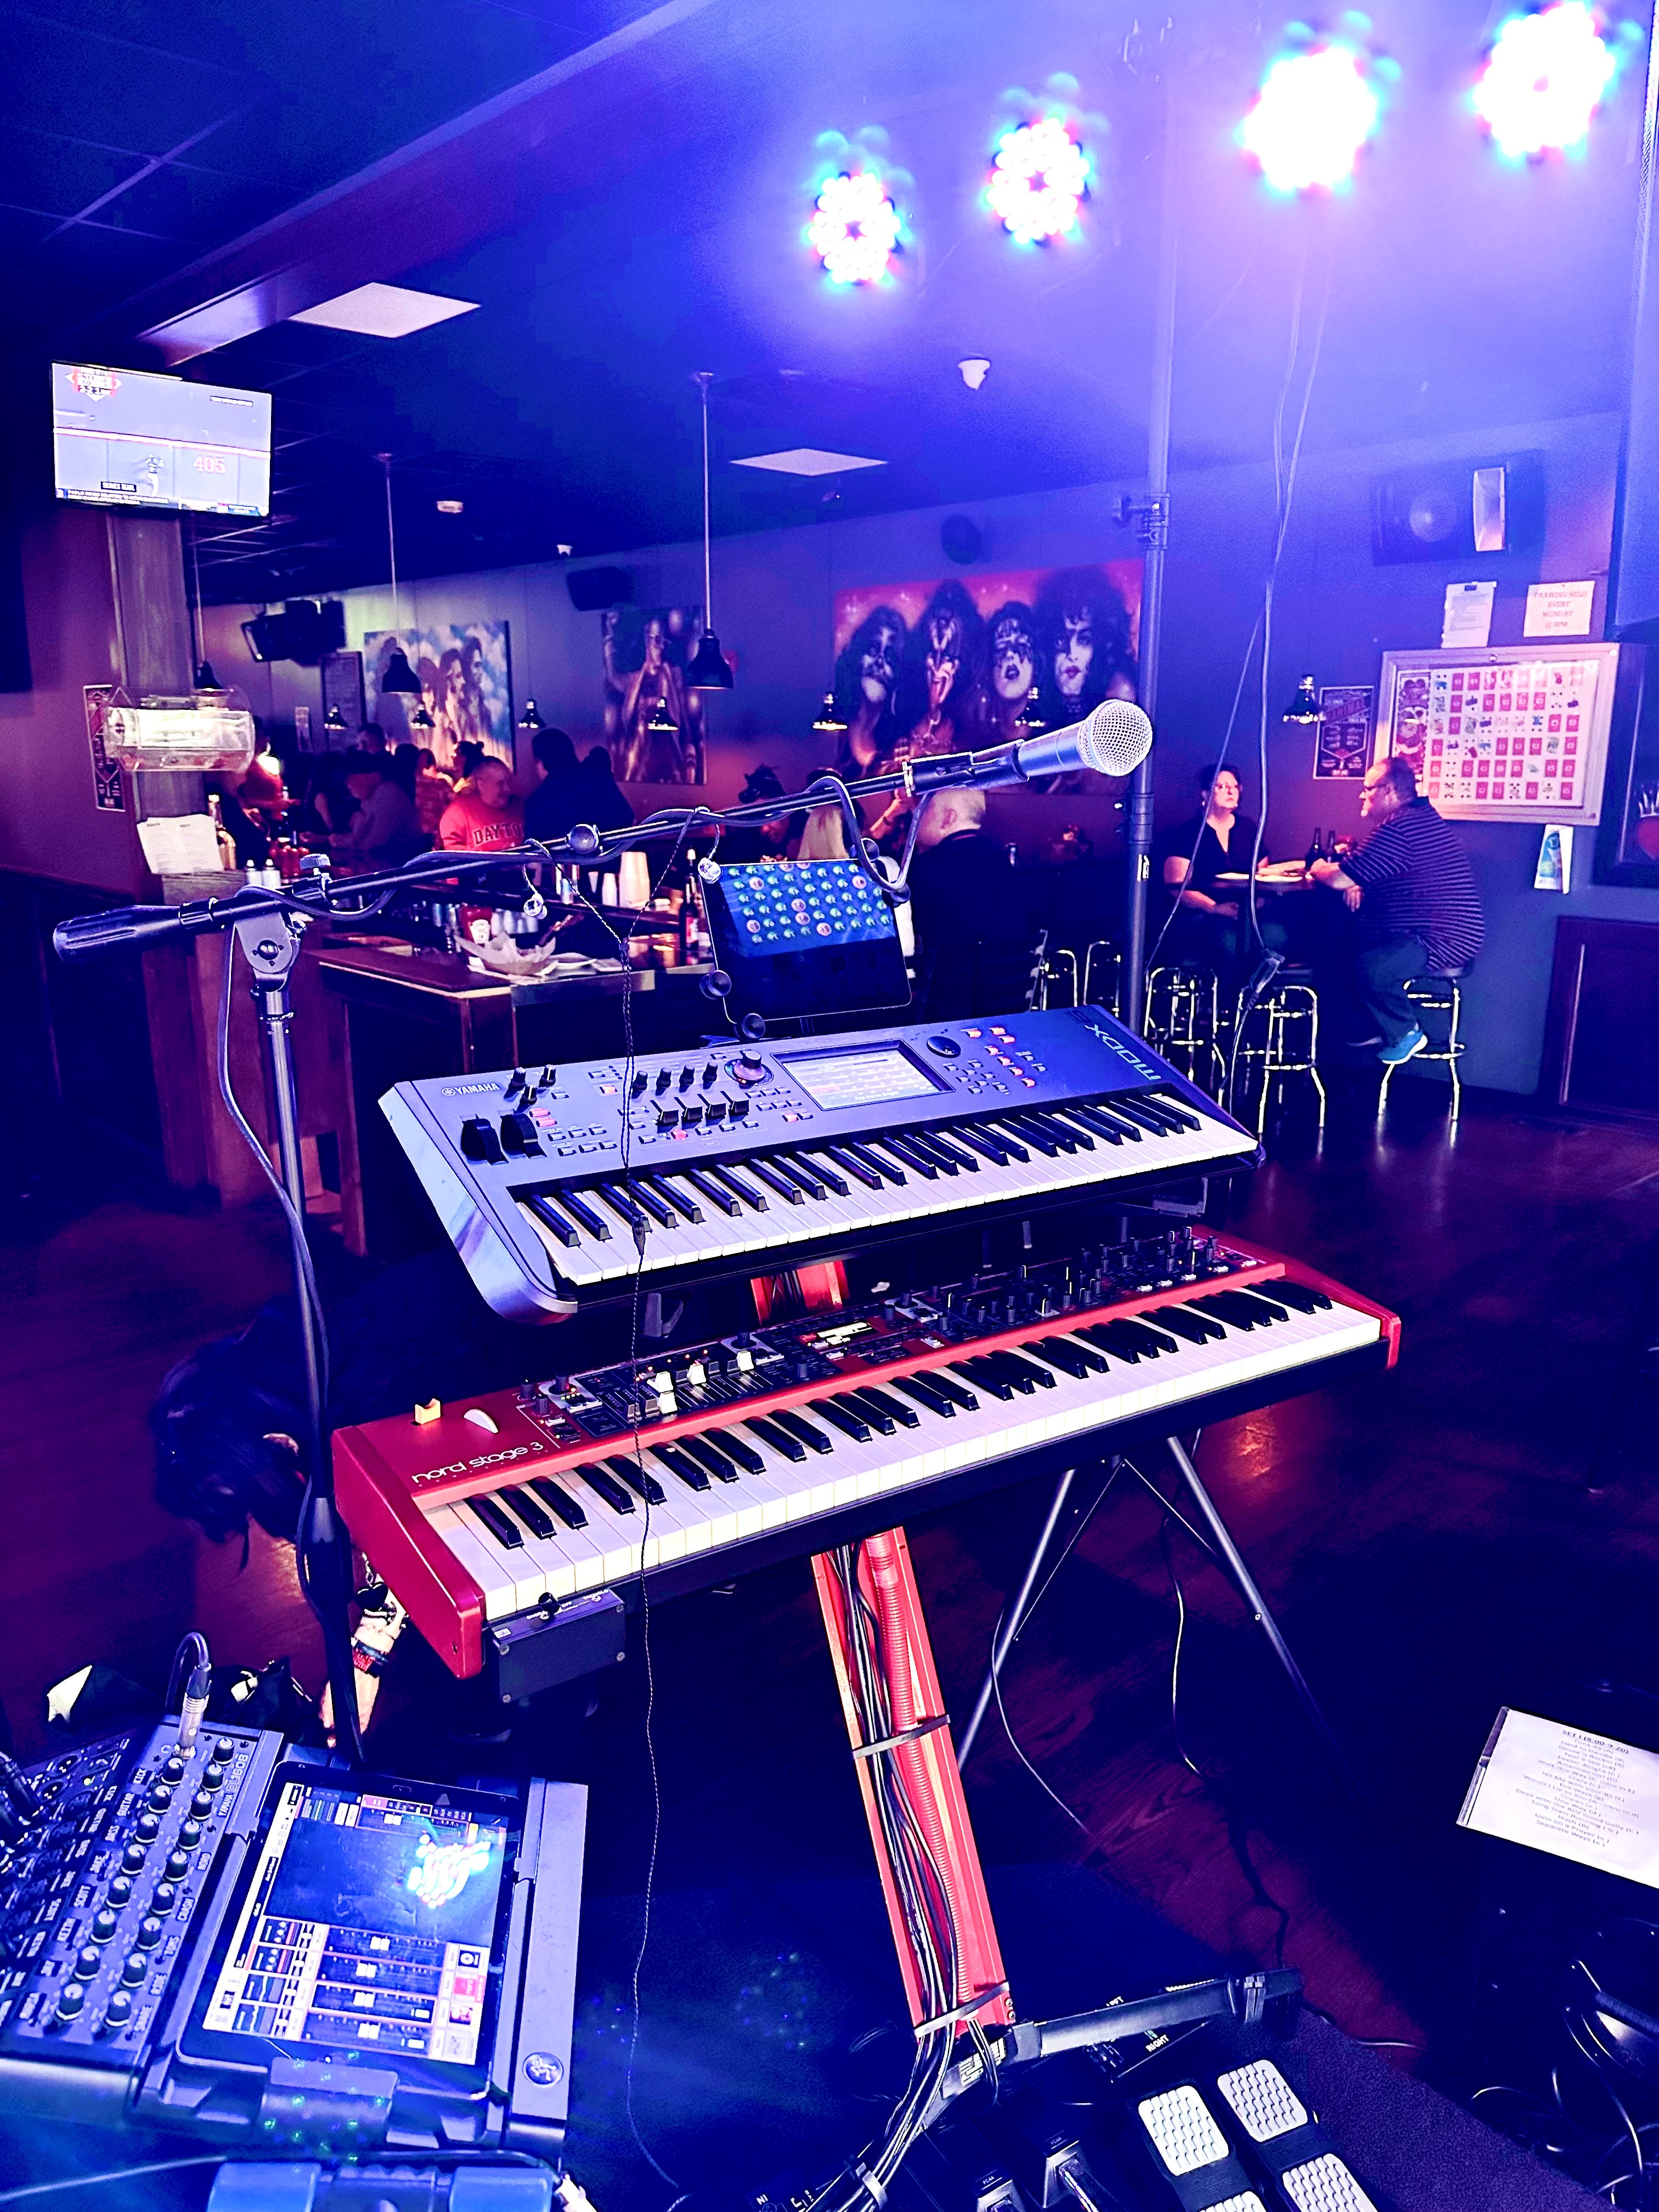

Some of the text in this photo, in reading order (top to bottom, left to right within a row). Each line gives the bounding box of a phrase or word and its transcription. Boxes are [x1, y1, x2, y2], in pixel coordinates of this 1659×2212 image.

[194, 455, 226, 475] 405
[455, 1082, 501, 1095] YAMAHA
[411, 1441, 544, 1483] nord stage 3
[133, 1768, 147, 1784] KICK
[1516, 1788, 1534, 1798] Devil
[116, 1792, 136, 1816] GUITAR
[218, 1793, 234, 1817] YAMAHA
[1536, 1820, 1569, 1835] Separate
[1570, 1832, 1591, 1842] Ways
[1571, 1826, 1595, 1838] Prayer
[1145, 2034, 1169, 2052] RIGHT
